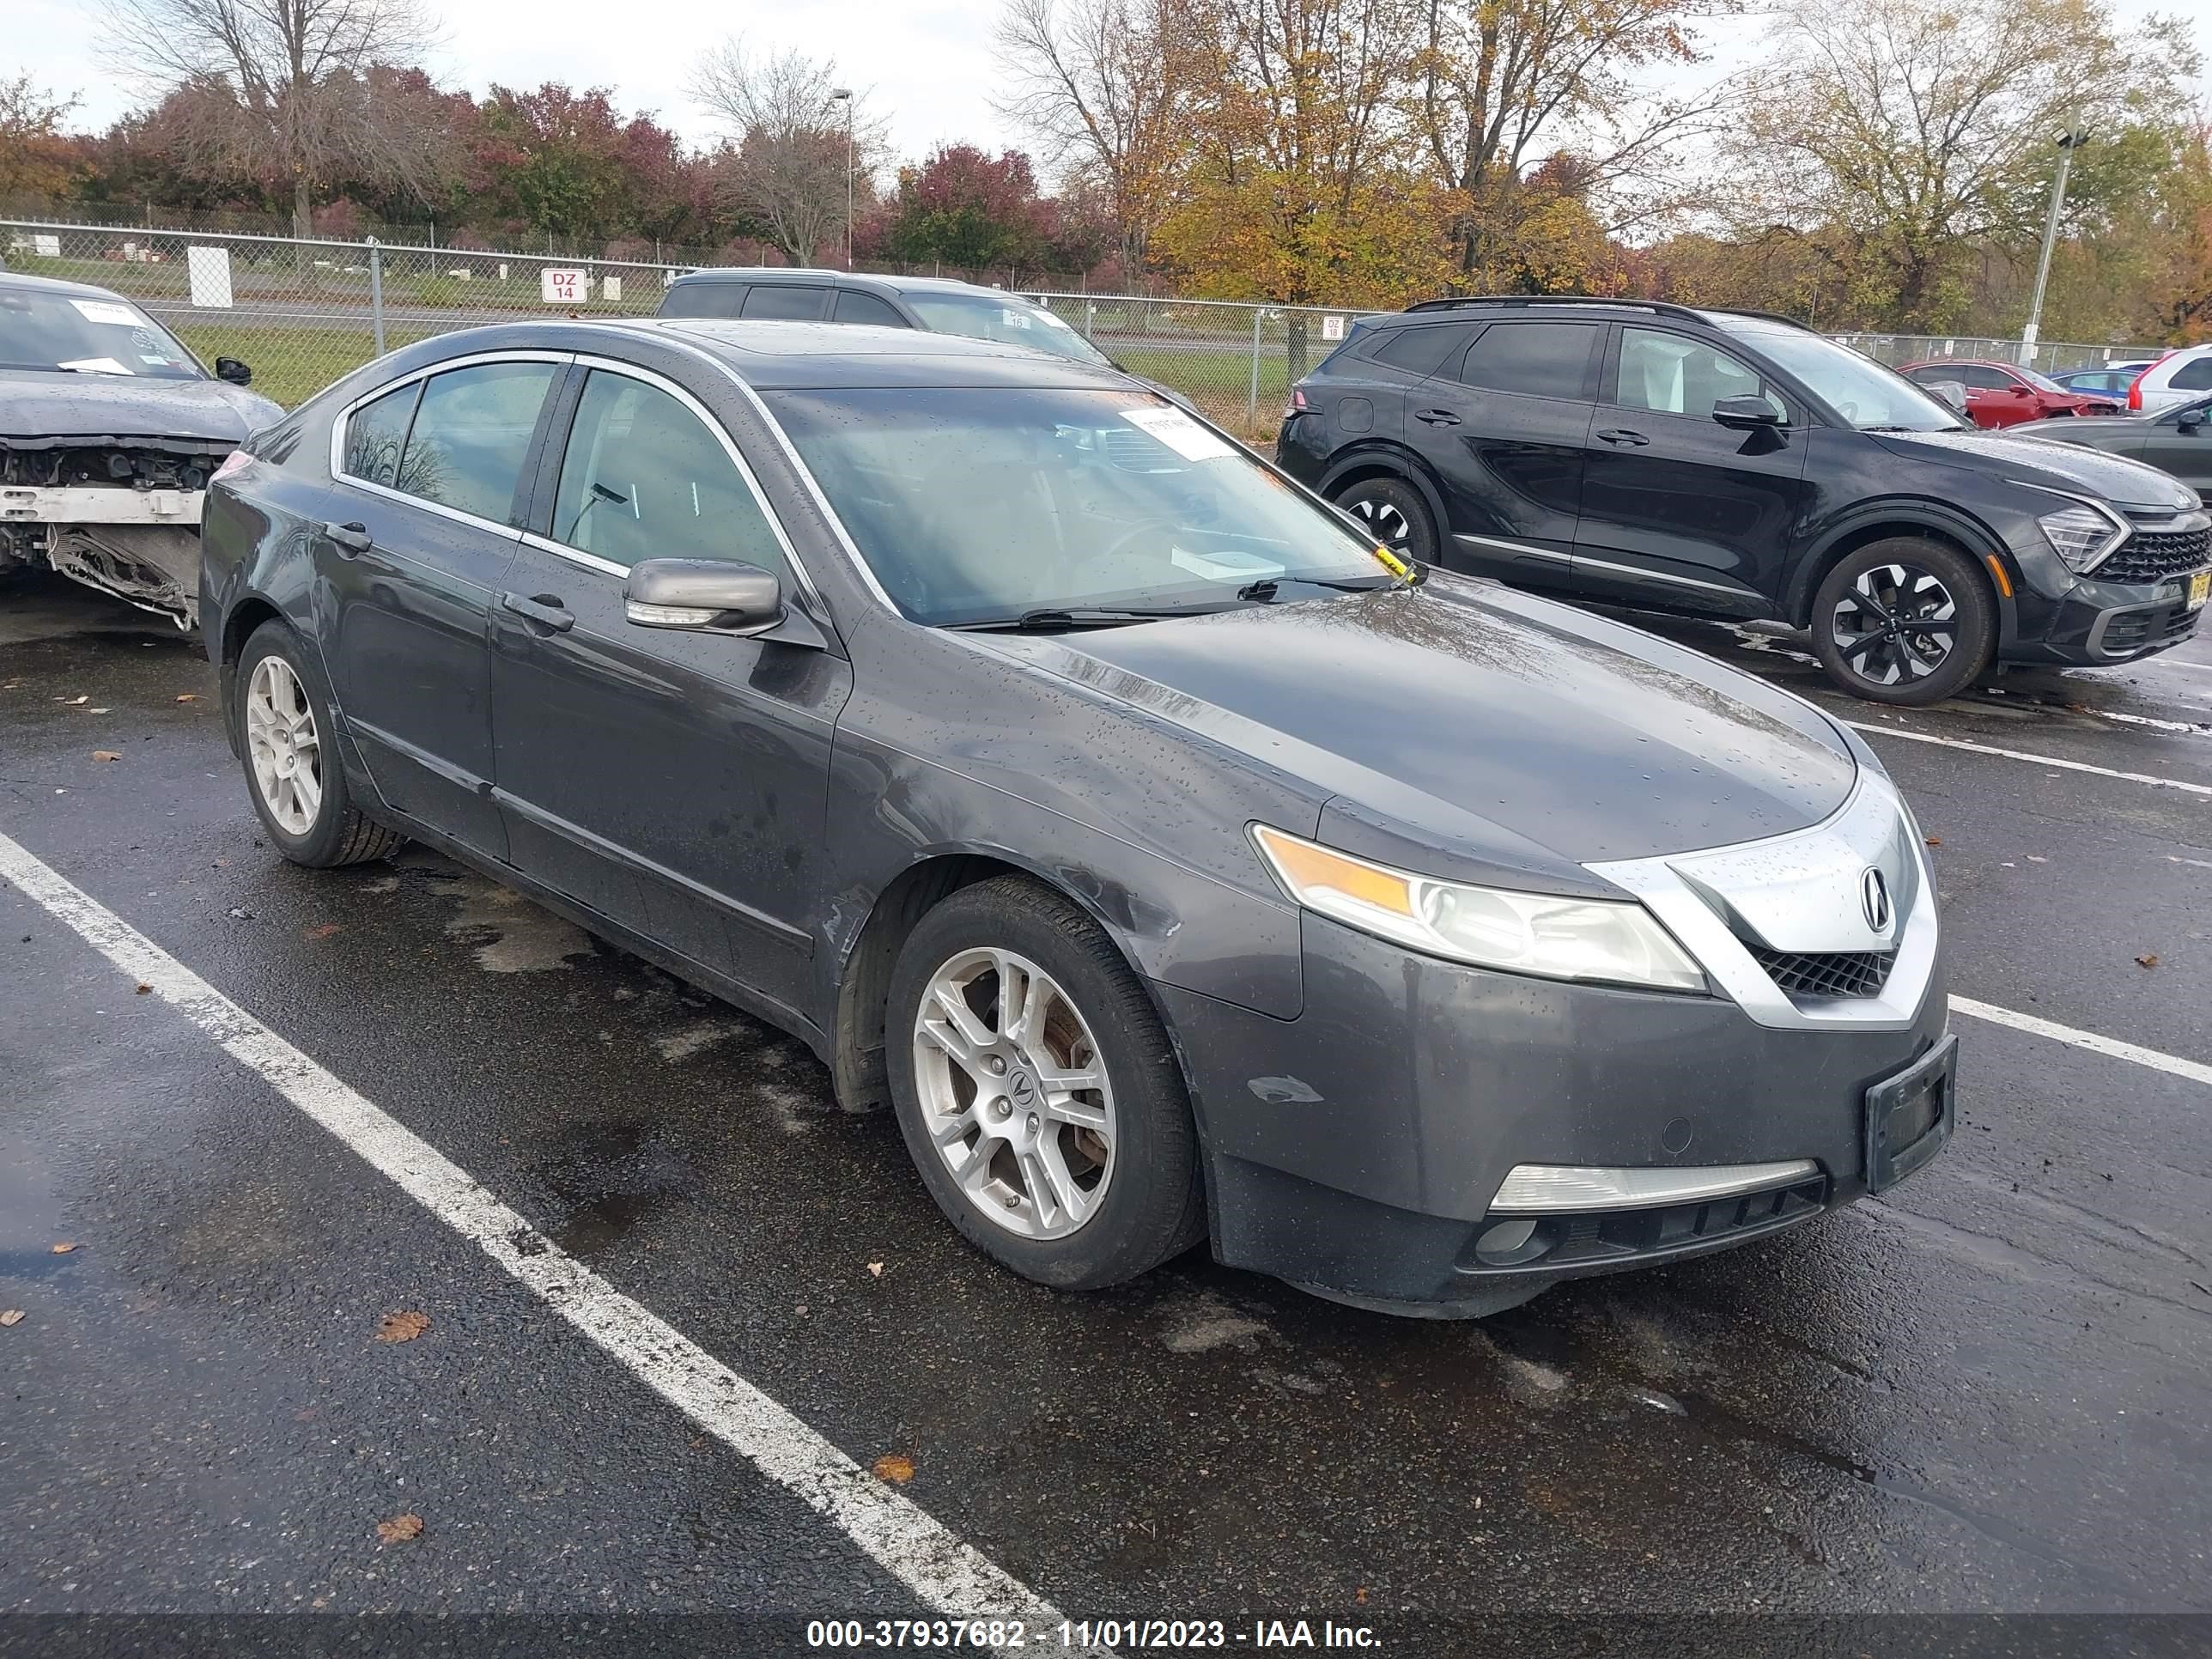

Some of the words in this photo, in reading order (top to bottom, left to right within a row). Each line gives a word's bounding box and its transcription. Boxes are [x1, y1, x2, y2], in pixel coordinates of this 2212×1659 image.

[553, 274, 576, 285] DZ
[556, 288, 574, 298] 14
[1012, 319, 1023, 327] 16
[1328, 319, 1340, 328] DZ
